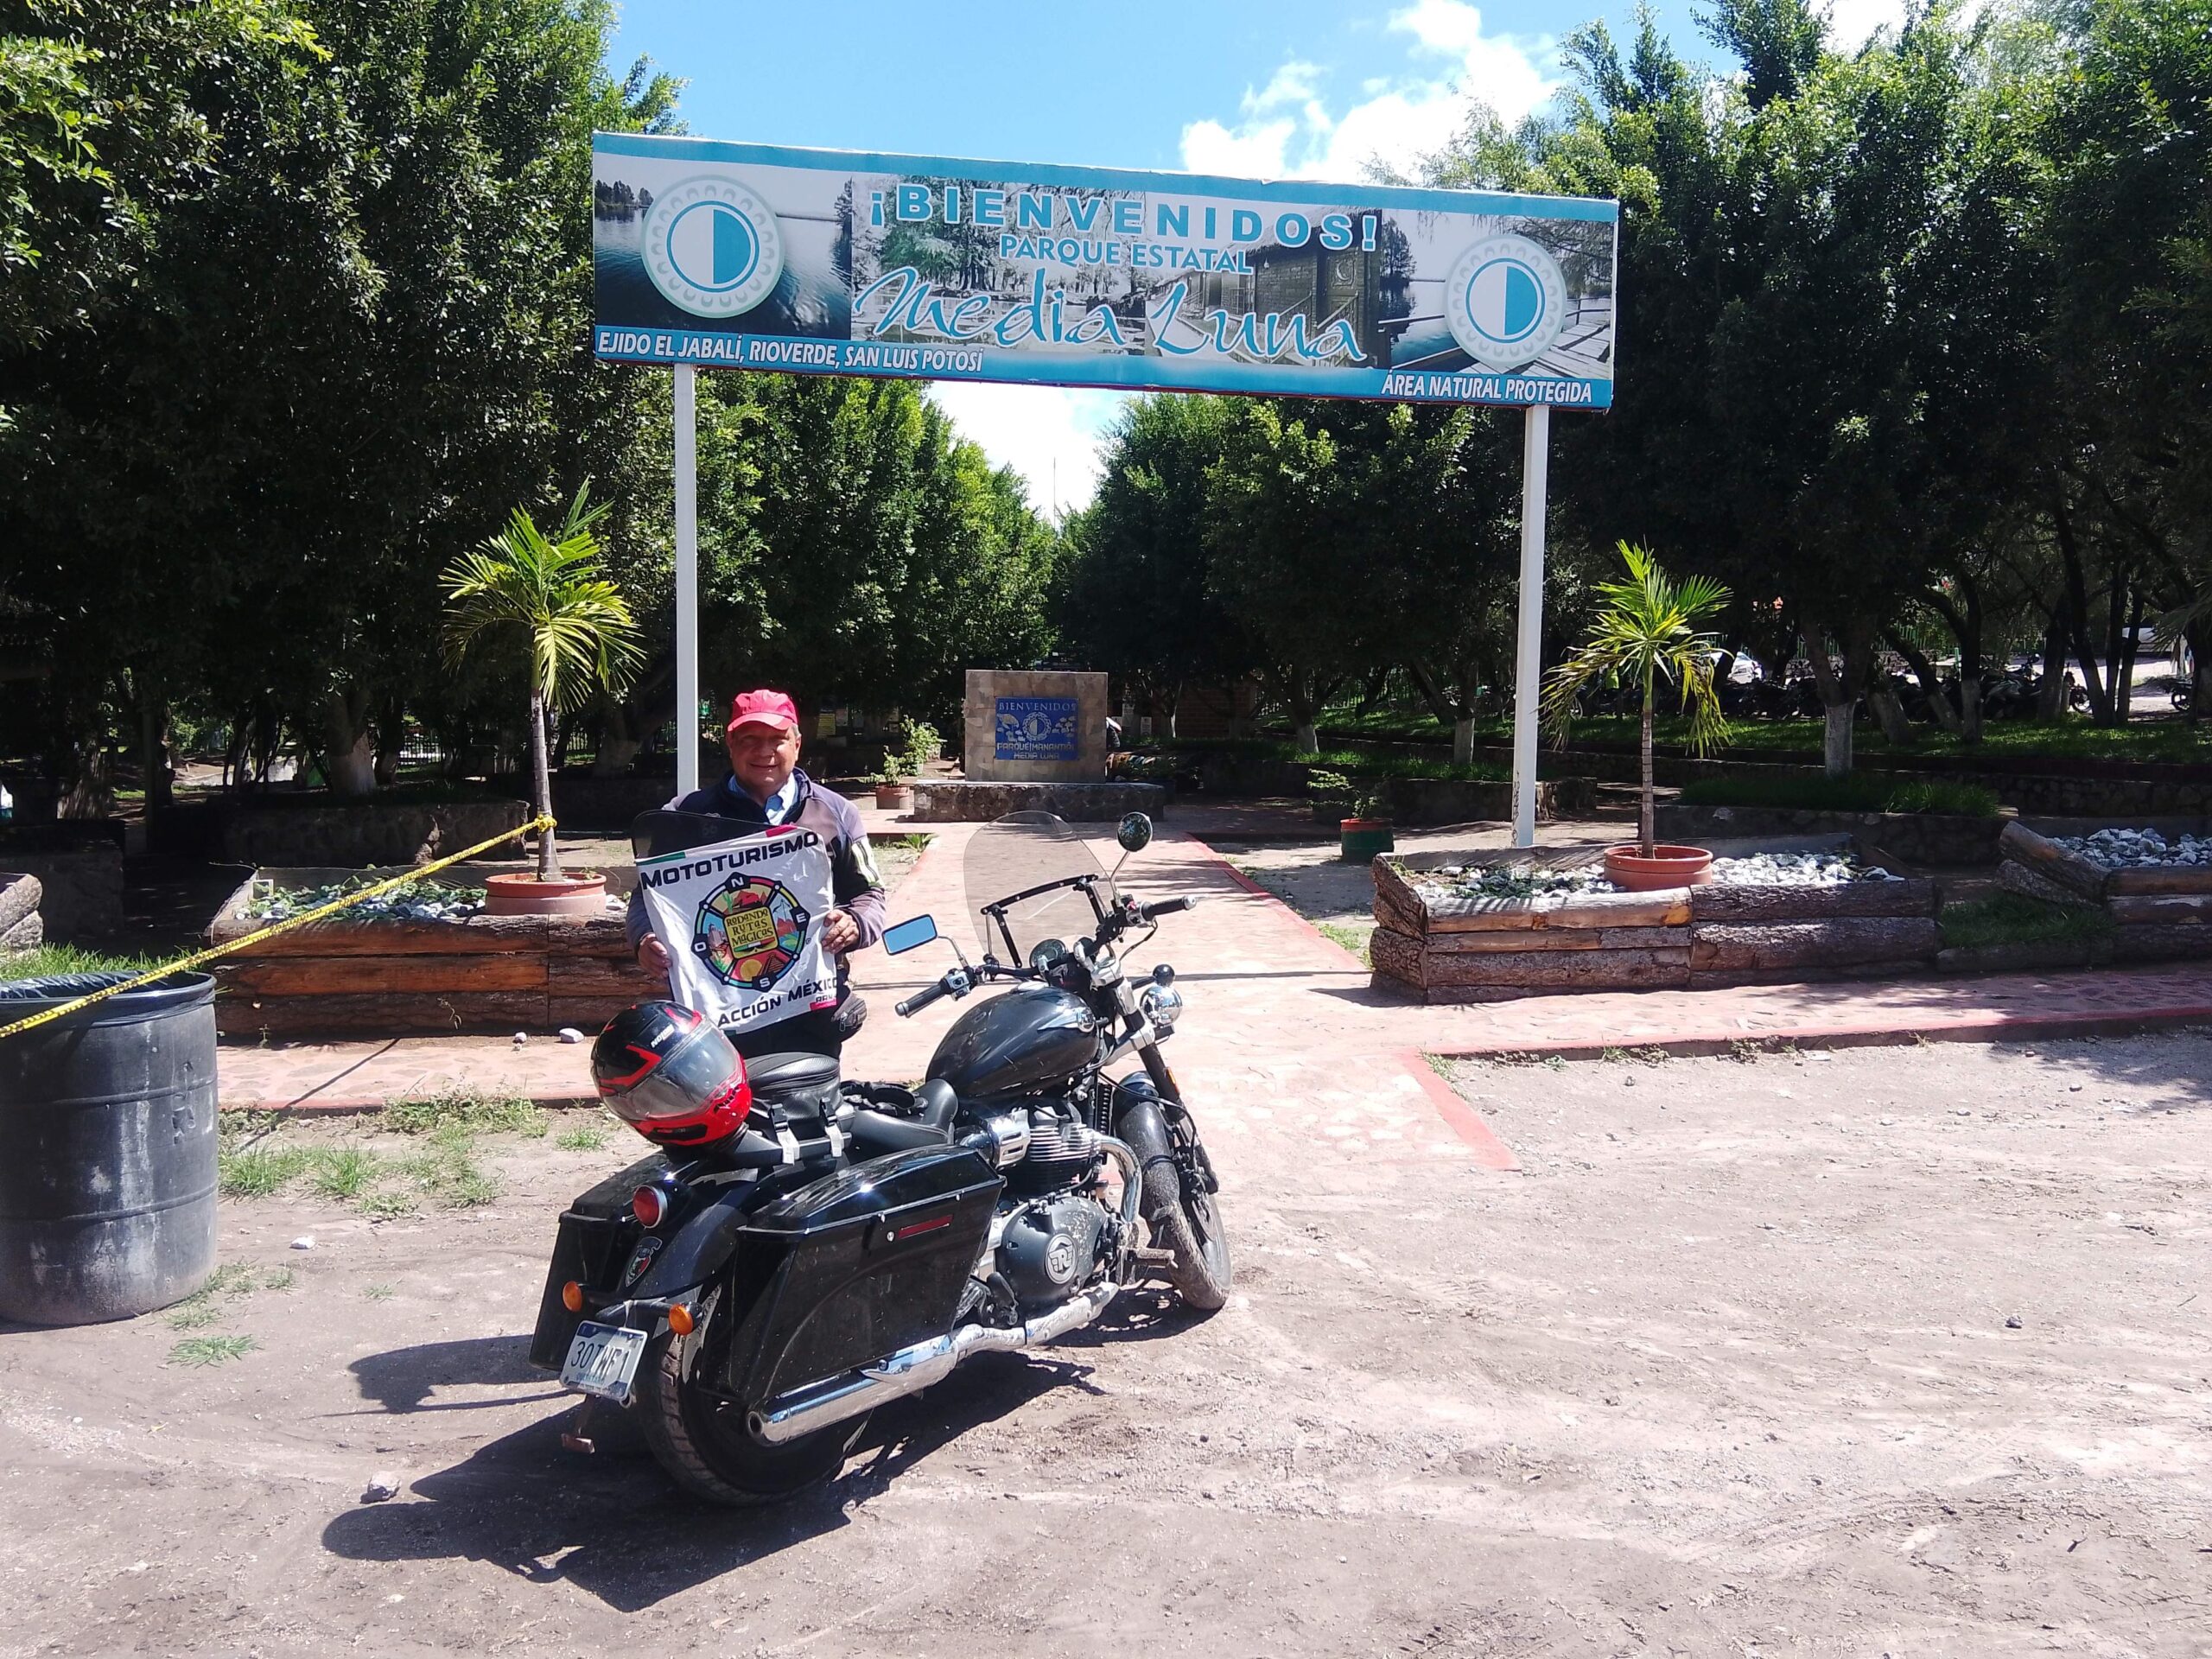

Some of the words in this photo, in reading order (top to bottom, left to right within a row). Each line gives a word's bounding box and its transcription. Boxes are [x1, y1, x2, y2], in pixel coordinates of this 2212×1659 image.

[870, 182, 1377, 251] ¡BIENVENIDOS!
[1000, 234, 1122, 269] PARQUE
[1130, 242, 1254, 275] ESTATAL
[853, 266, 1127, 347] Media
[1152, 281, 1368, 362] Luna
[598, 332, 651, 355] EJIDO
[654, 335, 675, 357] EL
[677, 334, 744, 364] JABALÍ,
[748, 340, 841, 369] RIOVERDE,
[843, 346, 880, 368] SAN
[882, 347, 918, 370] LUIS
[921, 348, 984, 372] POTOSÍ
[1381, 369, 1425, 397] ÁREA
[1428, 375, 1502, 400] NATURAL
[1504, 378, 1593, 404] PROTEGIDA
[999, 702, 1077, 711] BIENVENIDOS
[640, 831, 819, 889] MOTOTURISMO
[730, 876, 745, 887] N
[796, 912, 807, 923] E
[759, 977, 771, 988] S
[718, 997, 781, 1027] ACCIÓN
